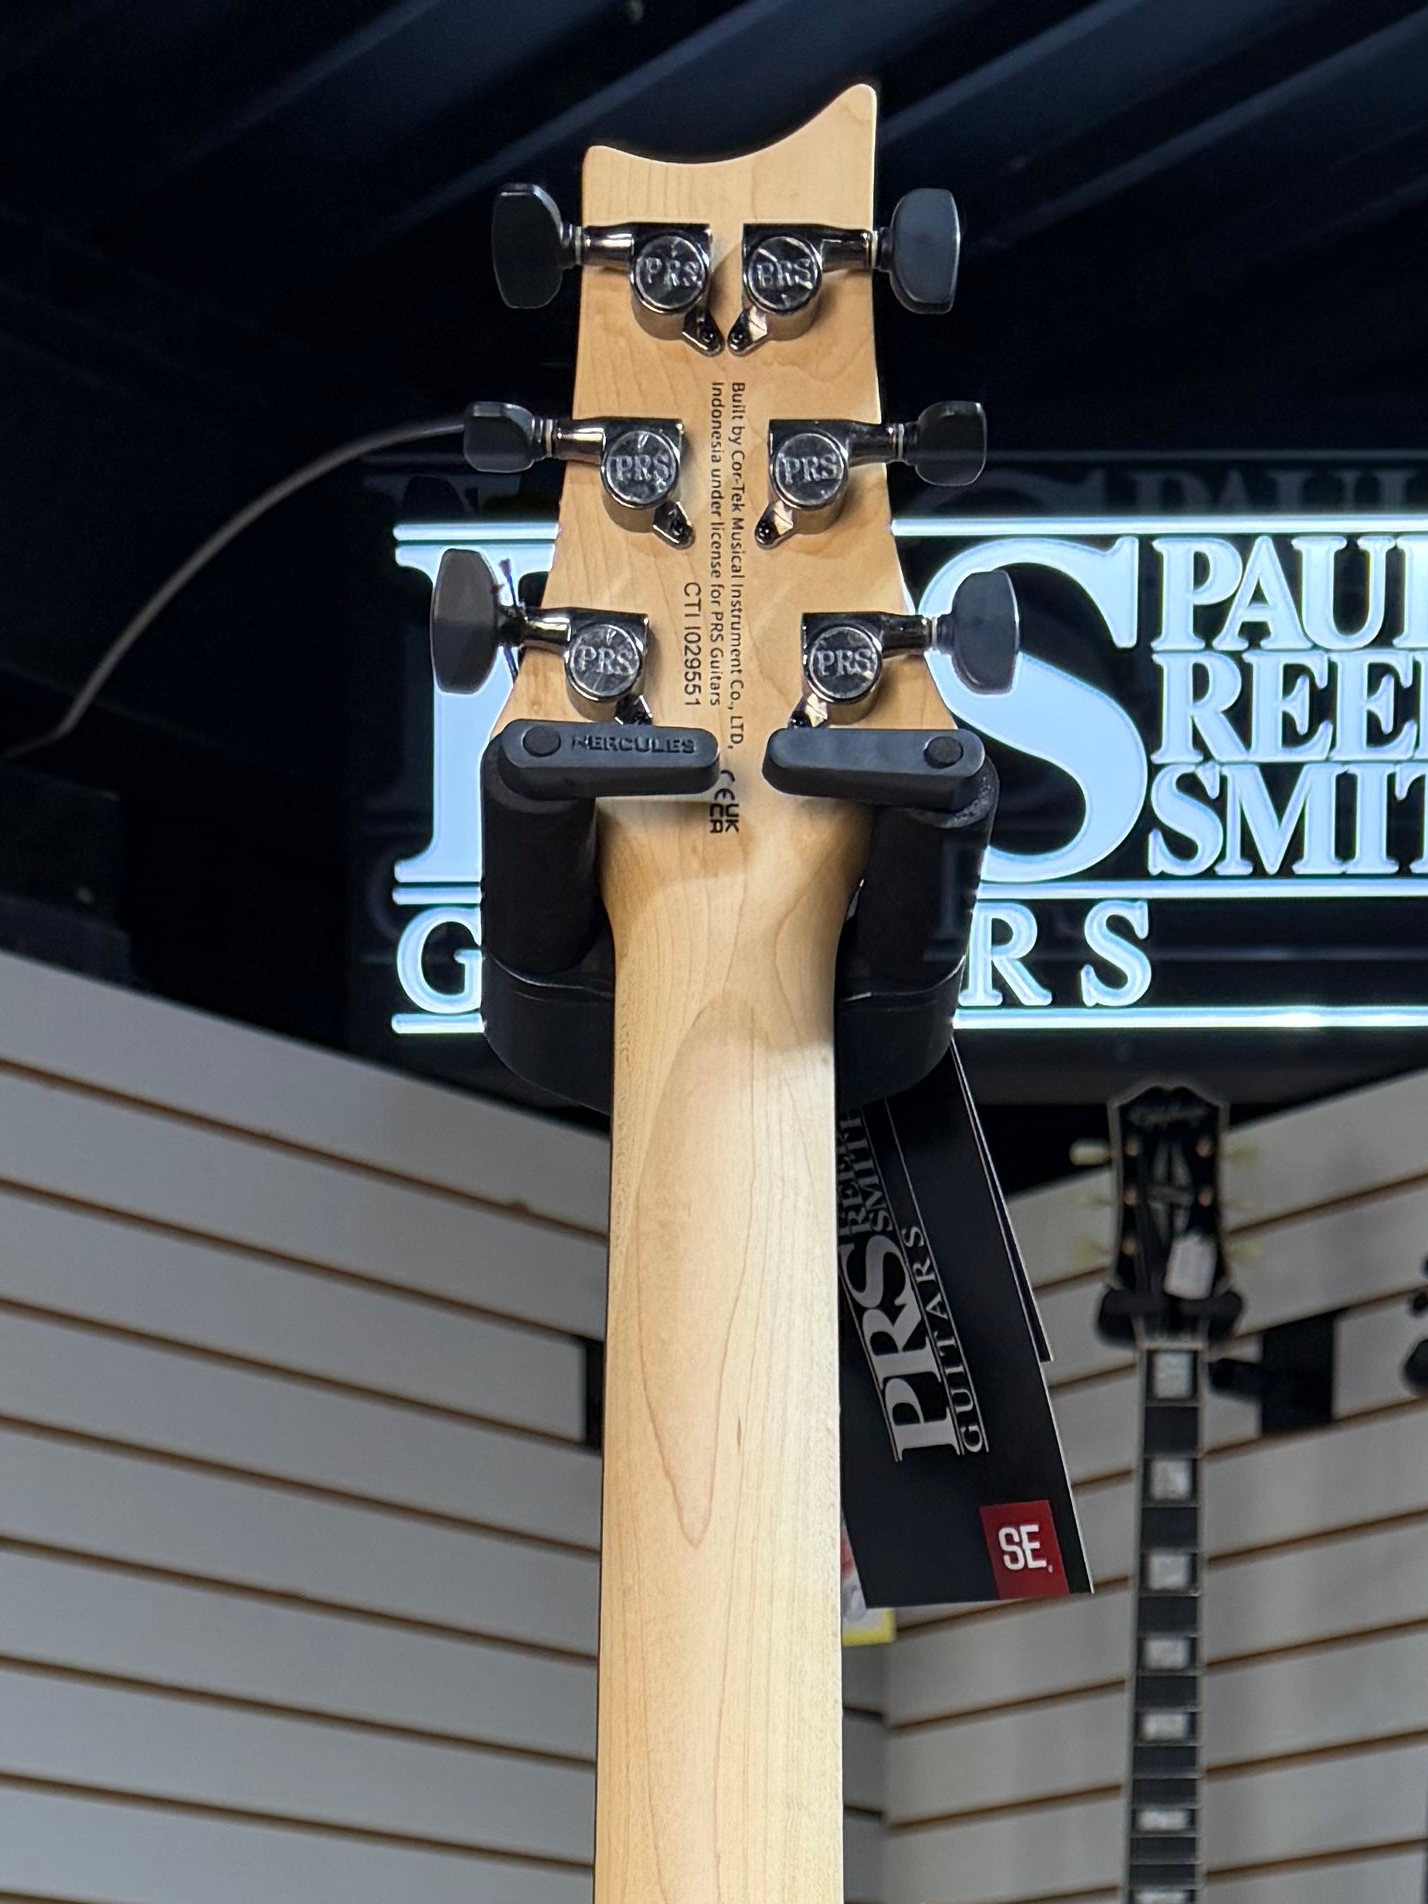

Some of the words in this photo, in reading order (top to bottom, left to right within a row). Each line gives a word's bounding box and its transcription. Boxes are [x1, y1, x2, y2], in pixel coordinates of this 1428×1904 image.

[645, 257, 701, 286] PRS
[756, 257, 812, 288] PRS
[731, 381, 746, 420] Built
[710, 381, 725, 463] Indonesia
[727, 426, 746, 445] by
[614, 453, 671, 485] PRS
[731, 450, 746, 512] Cor-Tek
[779, 452, 840, 485] PRS
[710, 468, 725, 517] under
[710, 522, 725, 578] license
[731, 517, 746, 579] Musical
[710, 584, 725, 606] for
[710, 611, 725, 641] PRS
[730, 583, 745, 674] Instrument
[578, 644, 636, 678] PRS
[710, 648, 725, 706] Guitars
[816, 649, 874, 677] PRS
[571, 733, 696, 756] HERCULES
[838, 1234, 961, 1459] PRS
[904, 1225, 985, 1454] GUITARS
[998, 1523, 1047, 1571] SE
